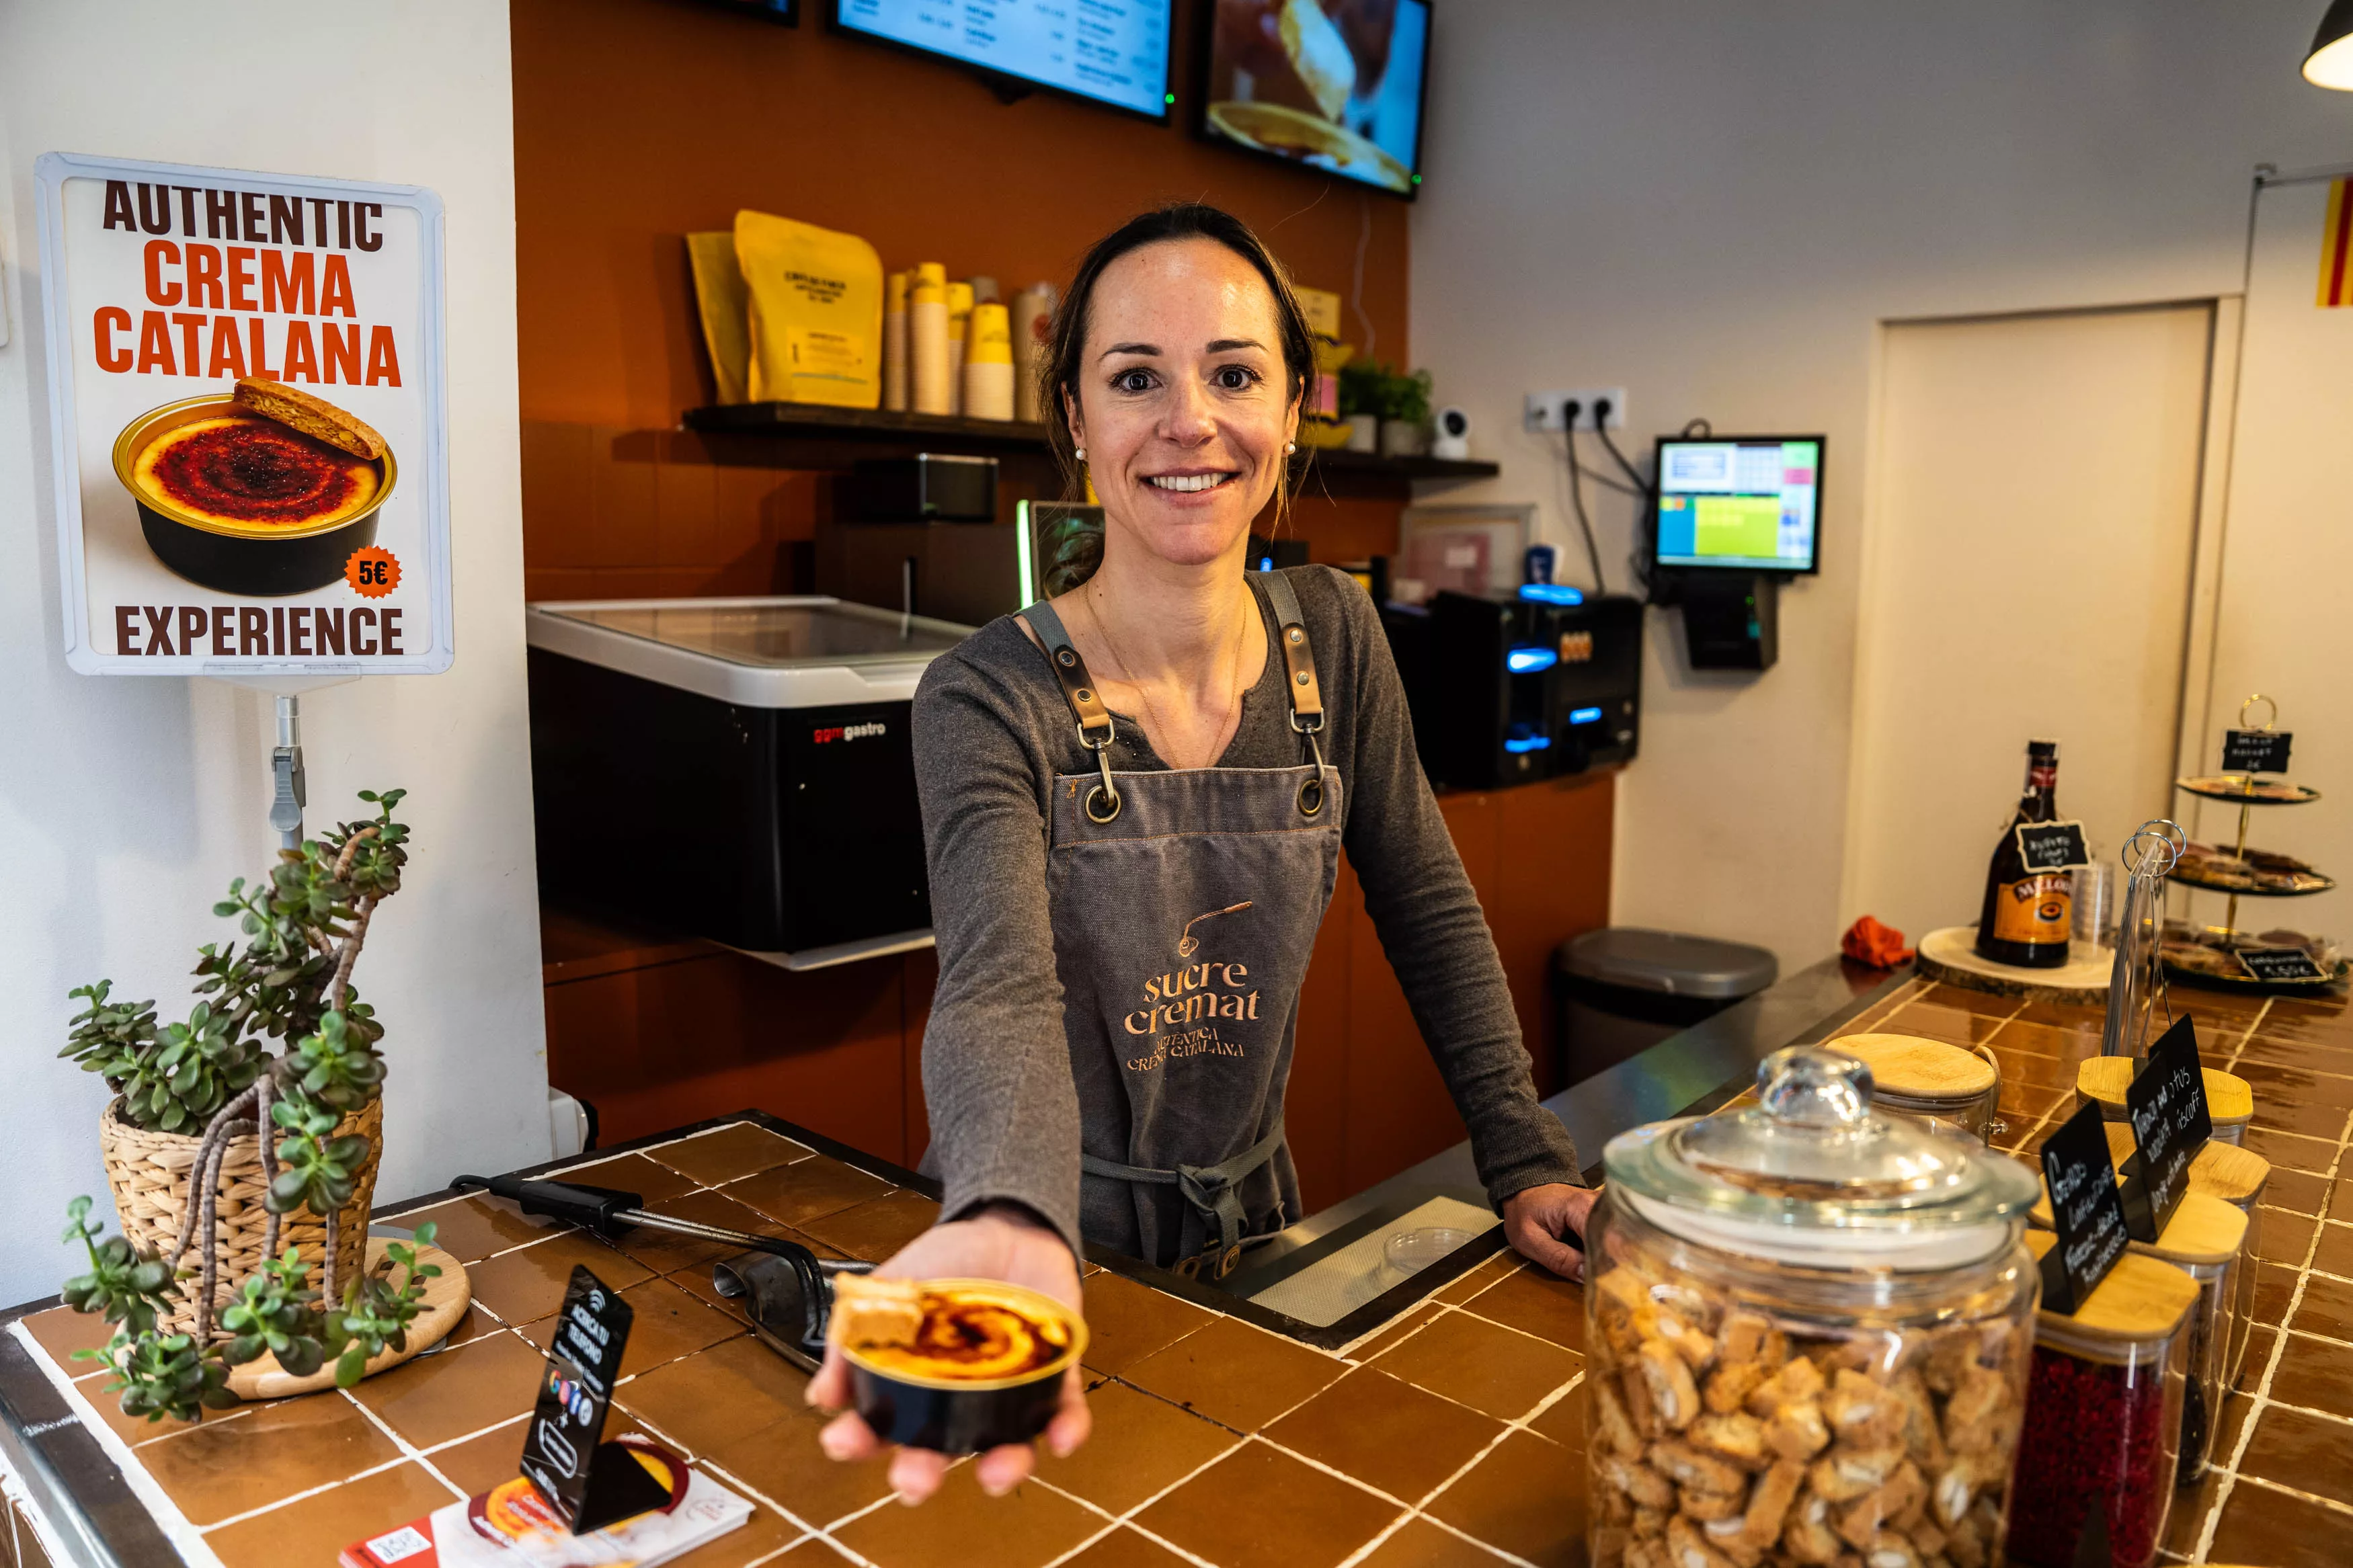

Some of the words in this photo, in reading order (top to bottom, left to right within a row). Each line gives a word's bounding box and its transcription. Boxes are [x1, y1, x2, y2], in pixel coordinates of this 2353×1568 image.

[103, 180, 384, 252] AUTHENTIC
[143, 239, 357, 318] CREMA
[93, 306, 403, 388] CATALANA
[358, 560, 388, 586] 5€
[115, 606, 404, 656] EXPERIENCE
[1143, 962, 1248, 1003] sucre
[1124, 990, 1261, 1035] cremat
[1170, 1040, 1244, 1058] CATALANA
